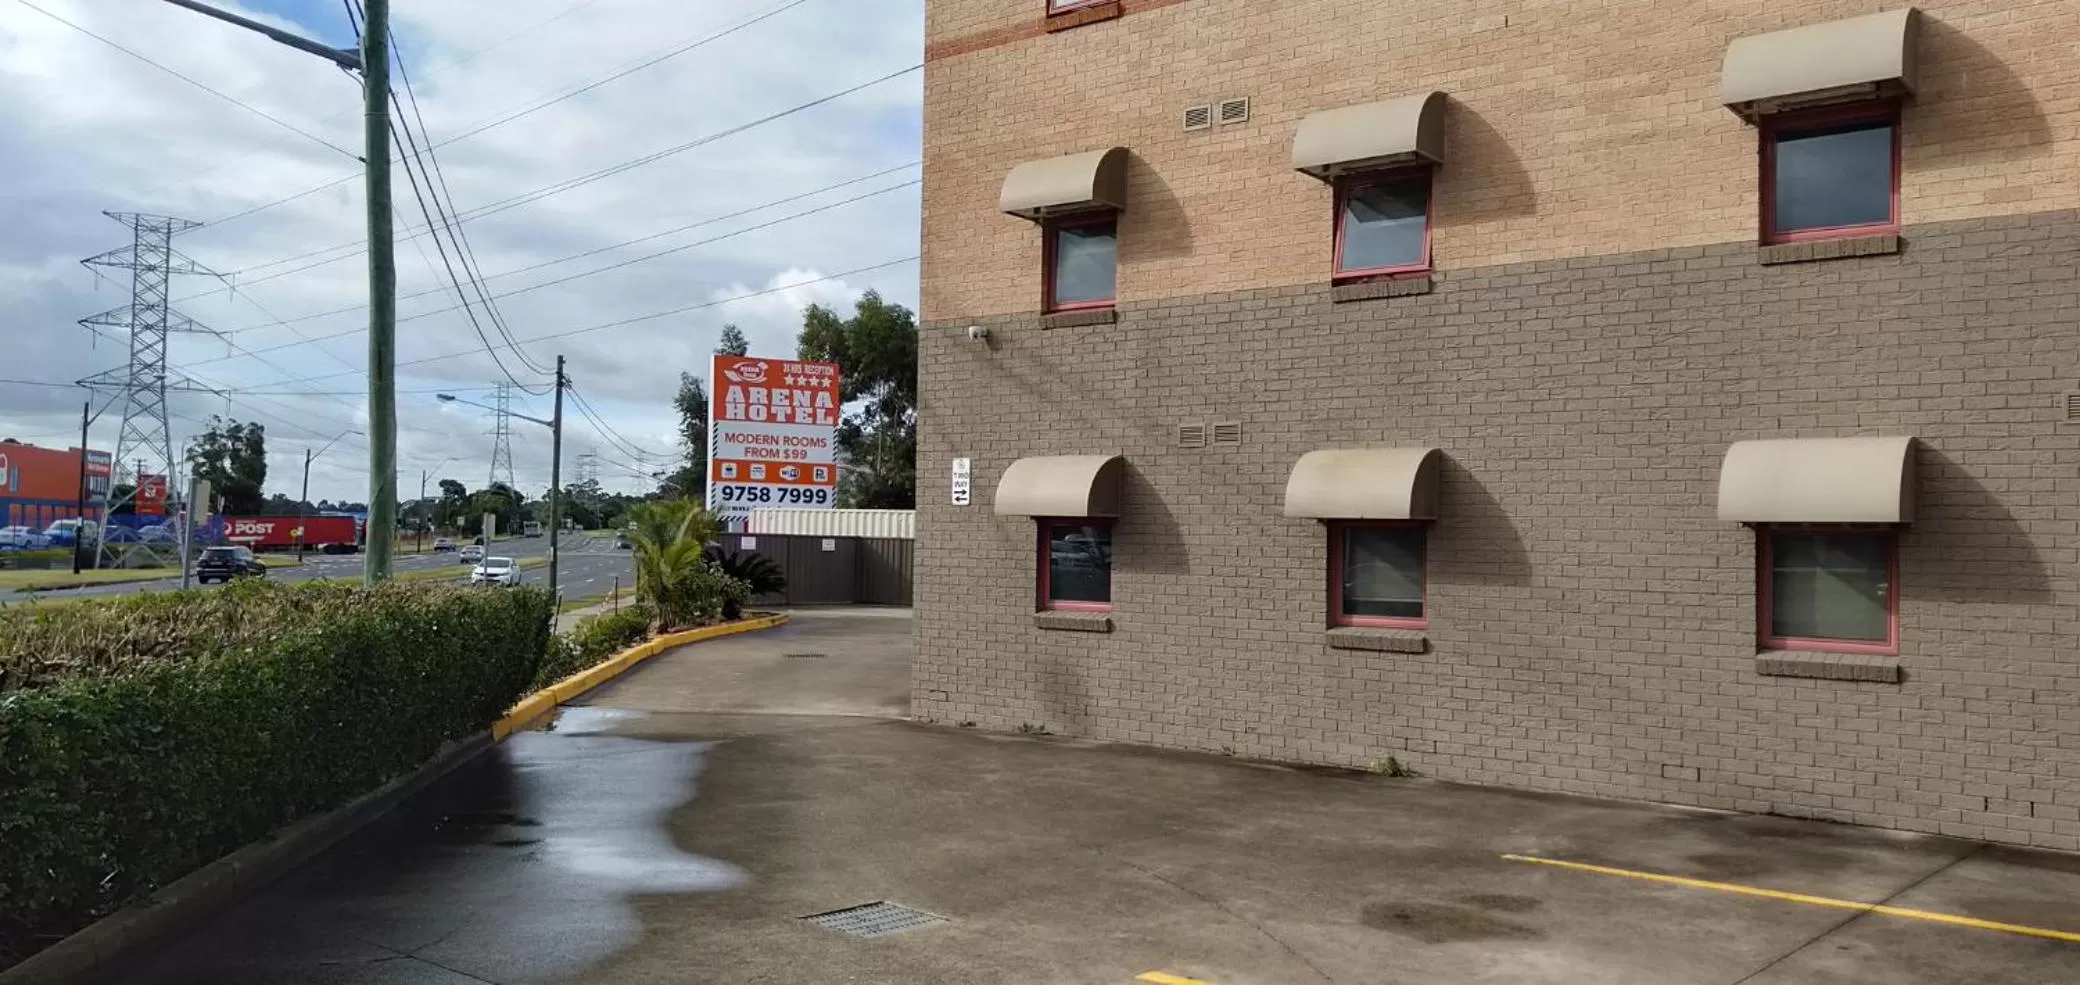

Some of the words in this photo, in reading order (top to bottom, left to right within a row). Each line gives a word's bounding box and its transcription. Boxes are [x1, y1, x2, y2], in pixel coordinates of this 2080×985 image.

[805, 365, 834, 375] RECEPTION
[724, 385, 834, 409] ARENA
[725, 403, 834, 425] HOTEL
[725, 432, 779, 447] MODERN
[783, 436, 828, 449] ROOMS
[744, 446, 780, 459] FROM
[783, 449, 808, 460] $99
[721, 485, 771, 503] 9758
[778, 487, 828, 504] 7999
[235, 523, 276, 534] POST
